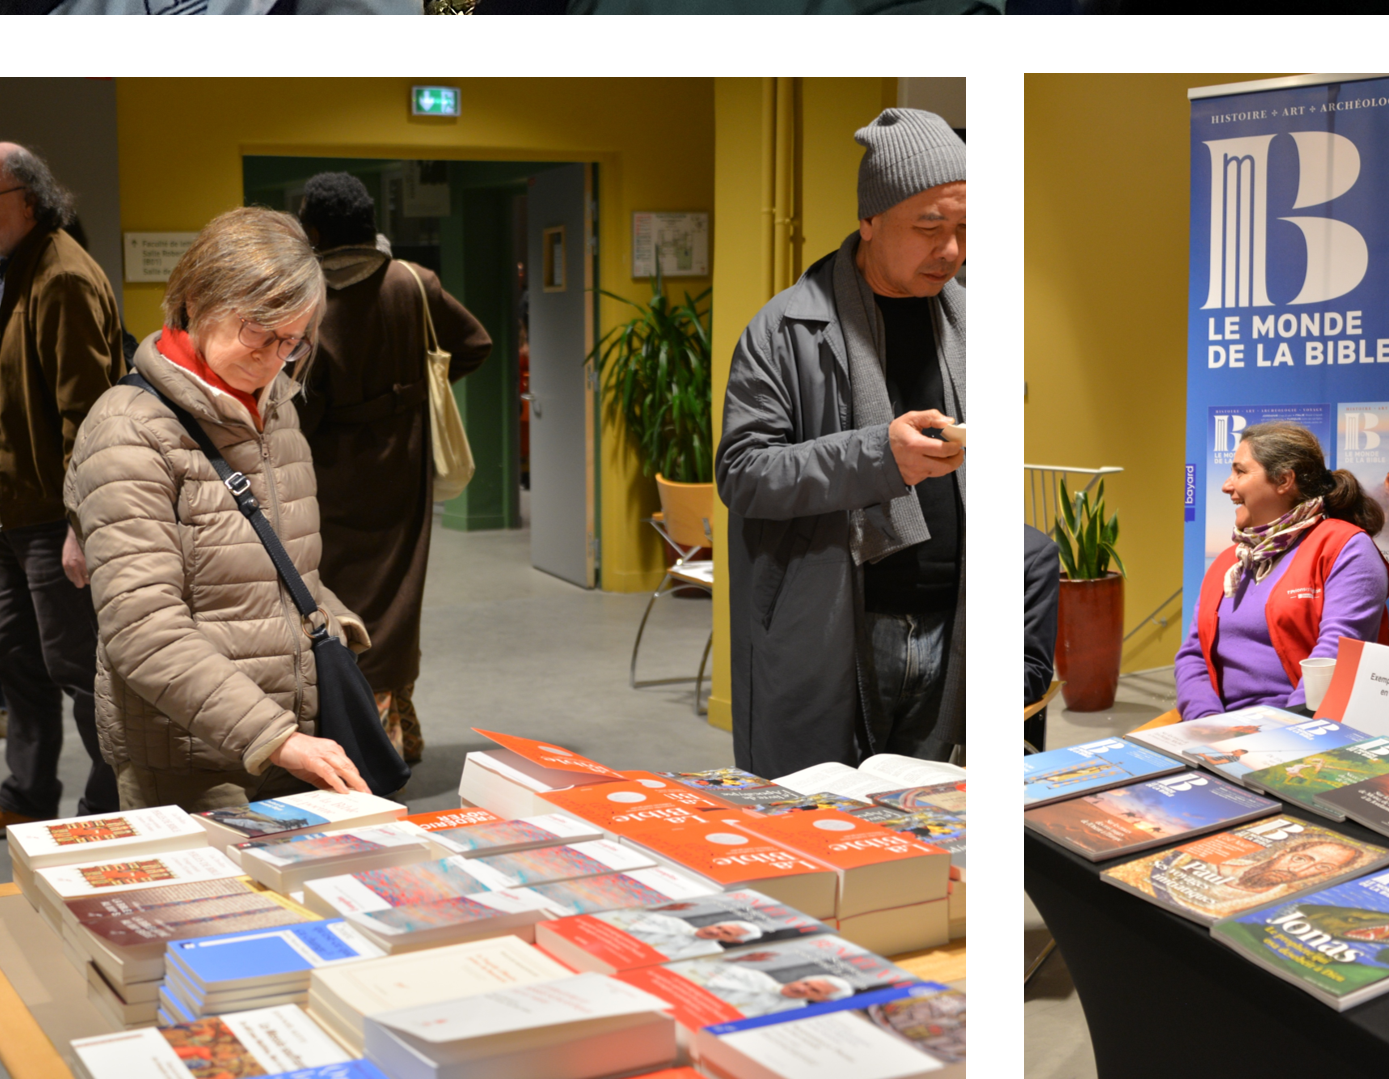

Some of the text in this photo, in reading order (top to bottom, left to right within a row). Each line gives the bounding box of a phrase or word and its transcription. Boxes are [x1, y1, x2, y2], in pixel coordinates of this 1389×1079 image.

[1211, 110, 1268, 124] HISTOIRE
[1282, 106, 1306, 117] ART
[1208, 310, 1363, 341] LE MONDE
[1208, 344, 1245, 368] DE
[1256, 343, 1294, 367] LA
[1185, 465, 1196, 504] bayard
[612, 807, 693, 823] Bible
[829, 836, 911, 852] Bible
[713, 851, 799, 866] Bible
[1182, 862, 1235, 886] Paul
[1266, 911, 1365, 963] Jonas
